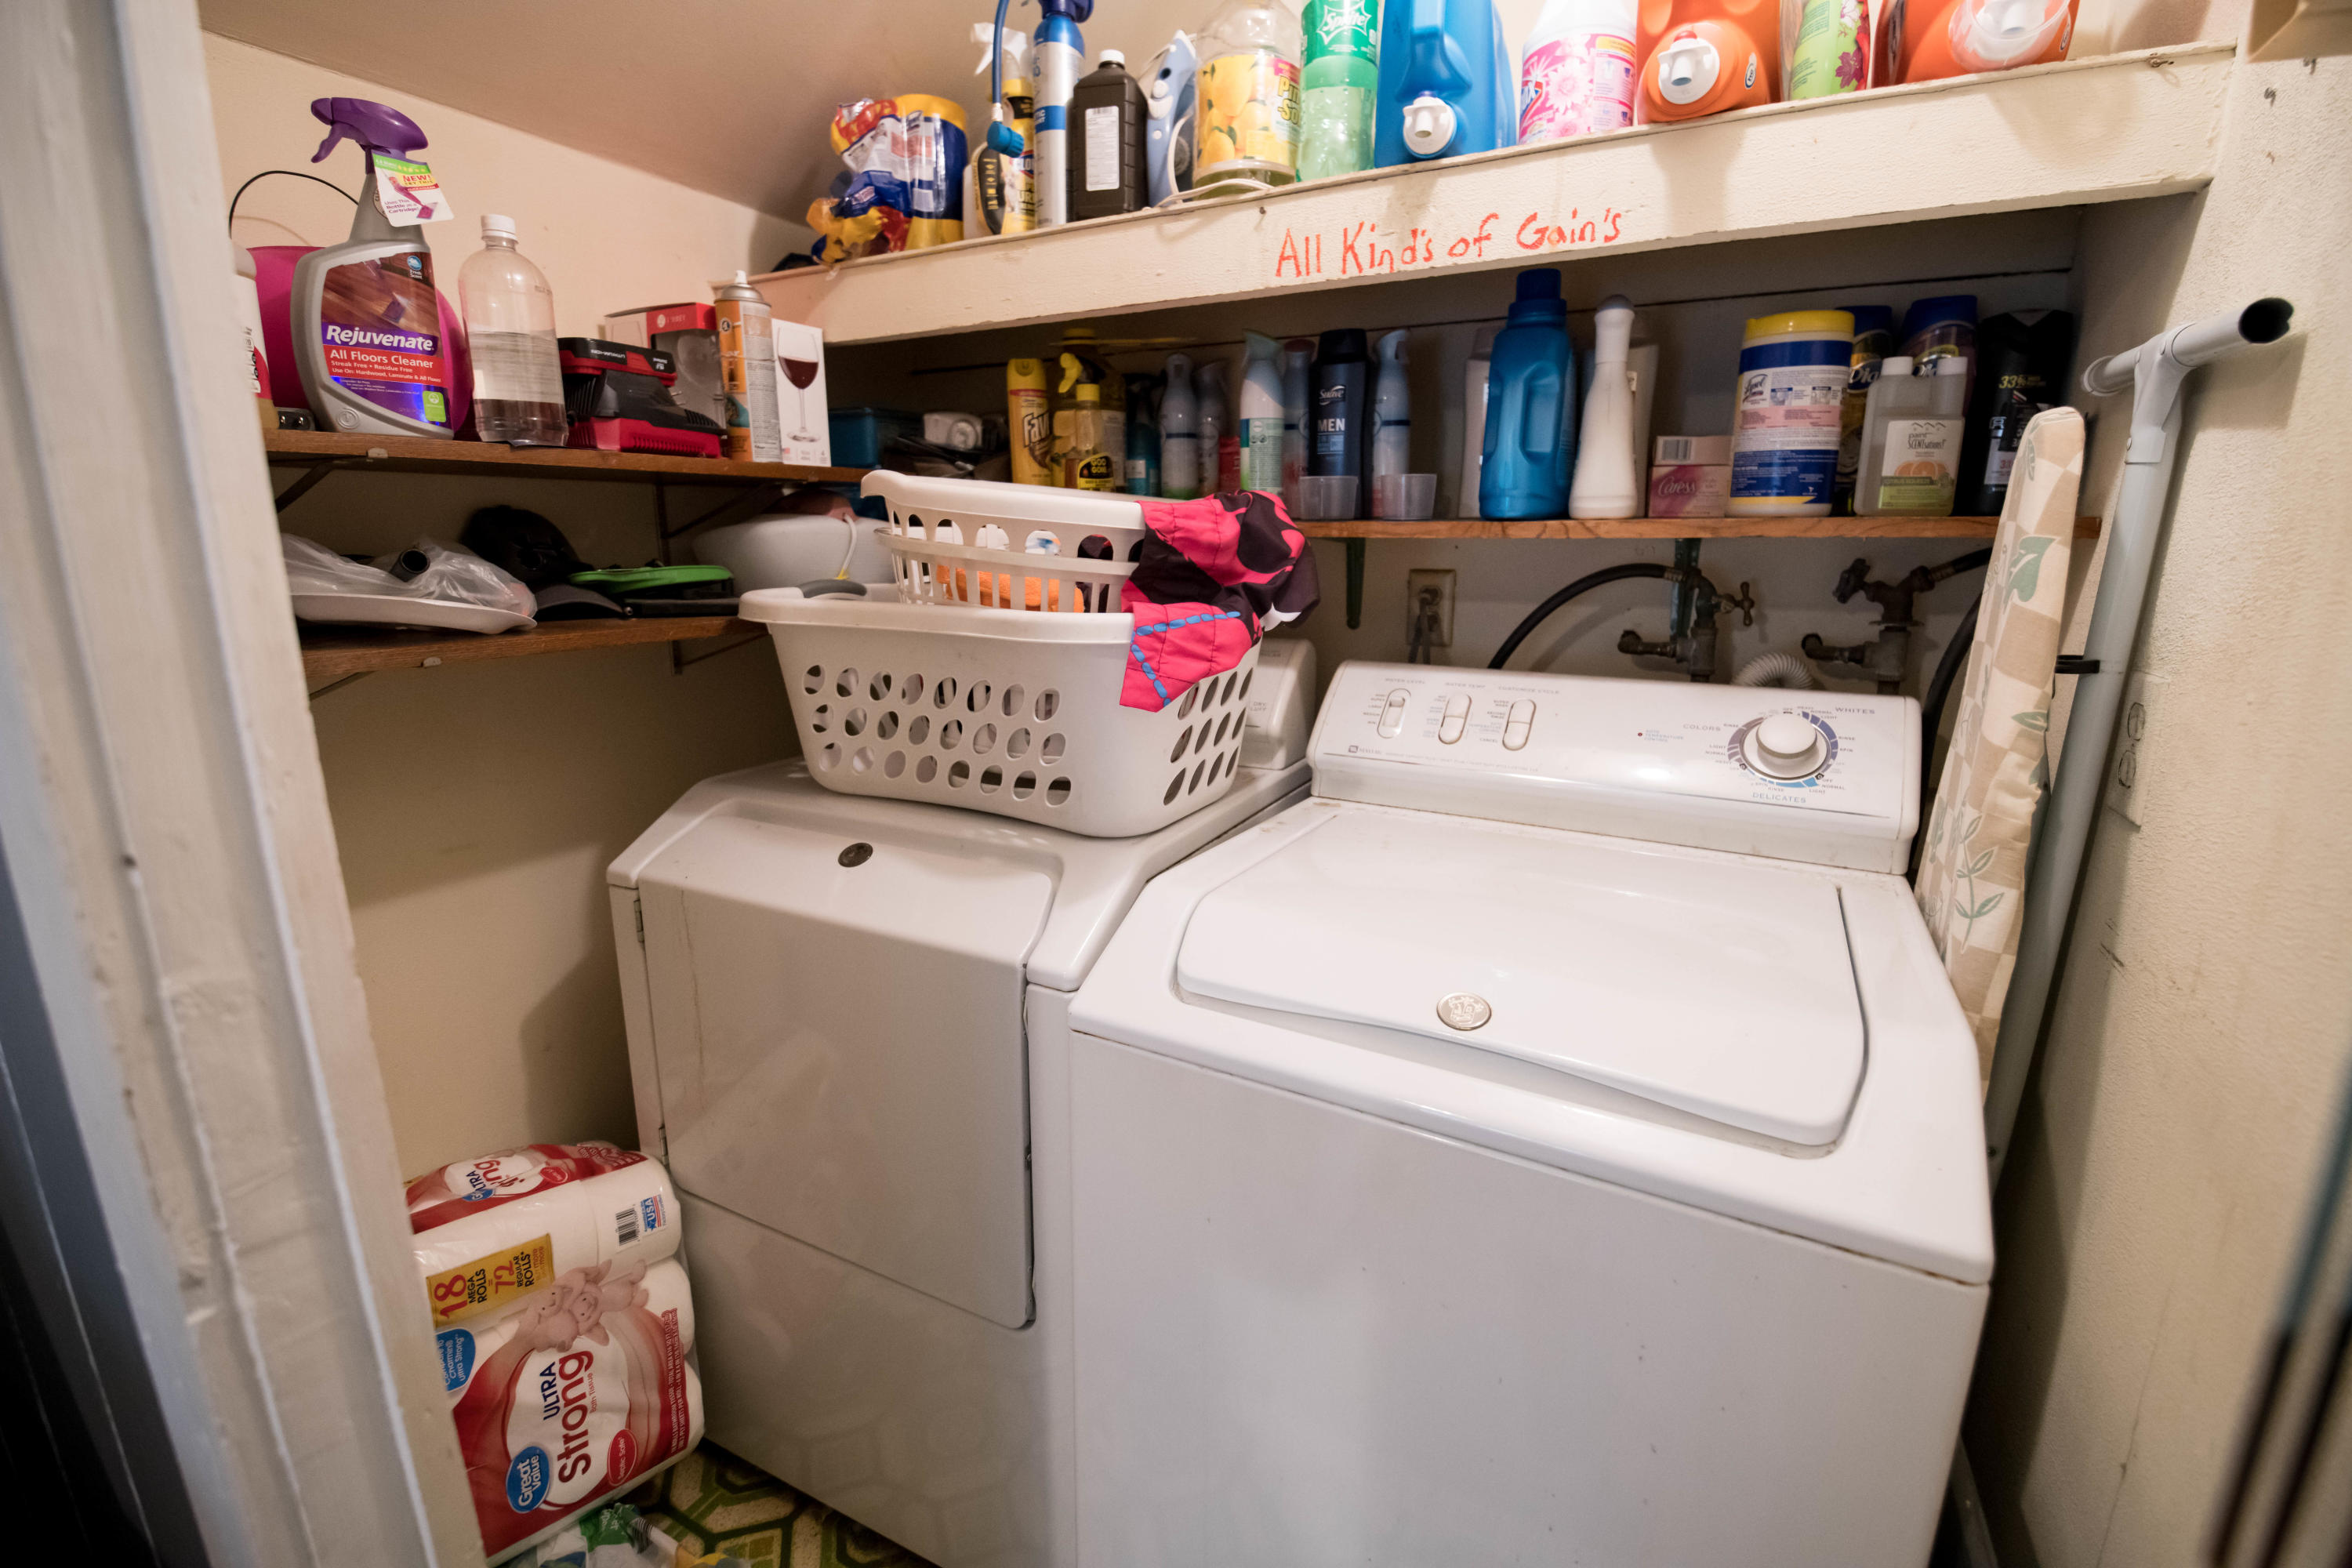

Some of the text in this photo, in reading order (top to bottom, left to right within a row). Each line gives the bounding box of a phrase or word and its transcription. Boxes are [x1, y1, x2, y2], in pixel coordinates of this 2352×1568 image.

[1322, 12, 1365, 31] Sprite
[402, 174, 431, 183] NEW!
[1275, 227, 1322, 278] All
[1447, 212, 1500, 258] of
[1515, 207, 1621, 251] Gain's
[325, 325, 434, 351] Rejuvenate
[330, 349, 434, 368] All Floors Cleaner
[1849, 366, 1880, 384] Dia
[1023, 410, 1051, 448] Fav
[1317, 418, 1345, 431] MEN
[1657, 476, 1696, 498] Caress
[1835, 706, 1875, 715] WHITES
[1682, 723, 1722, 731] COLORS
[1752, 792, 1807, 804] DELICATES
[644, 1198, 655, 1221] USA
[493, 1260, 516, 1294] 72
[513, 1255, 524, 1287] REGULAR
[434, 1274, 467, 1319] 18
[467, 1276, 477, 1304] MEGA
[476, 1268, 488, 1304] ROLLS
[539, 1361, 561, 1420] ULTRA
[586, 1372, 597, 1395] Tissue
[557, 1350, 594, 1483] Strong
[516, 1454, 542, 1506] Great Value
